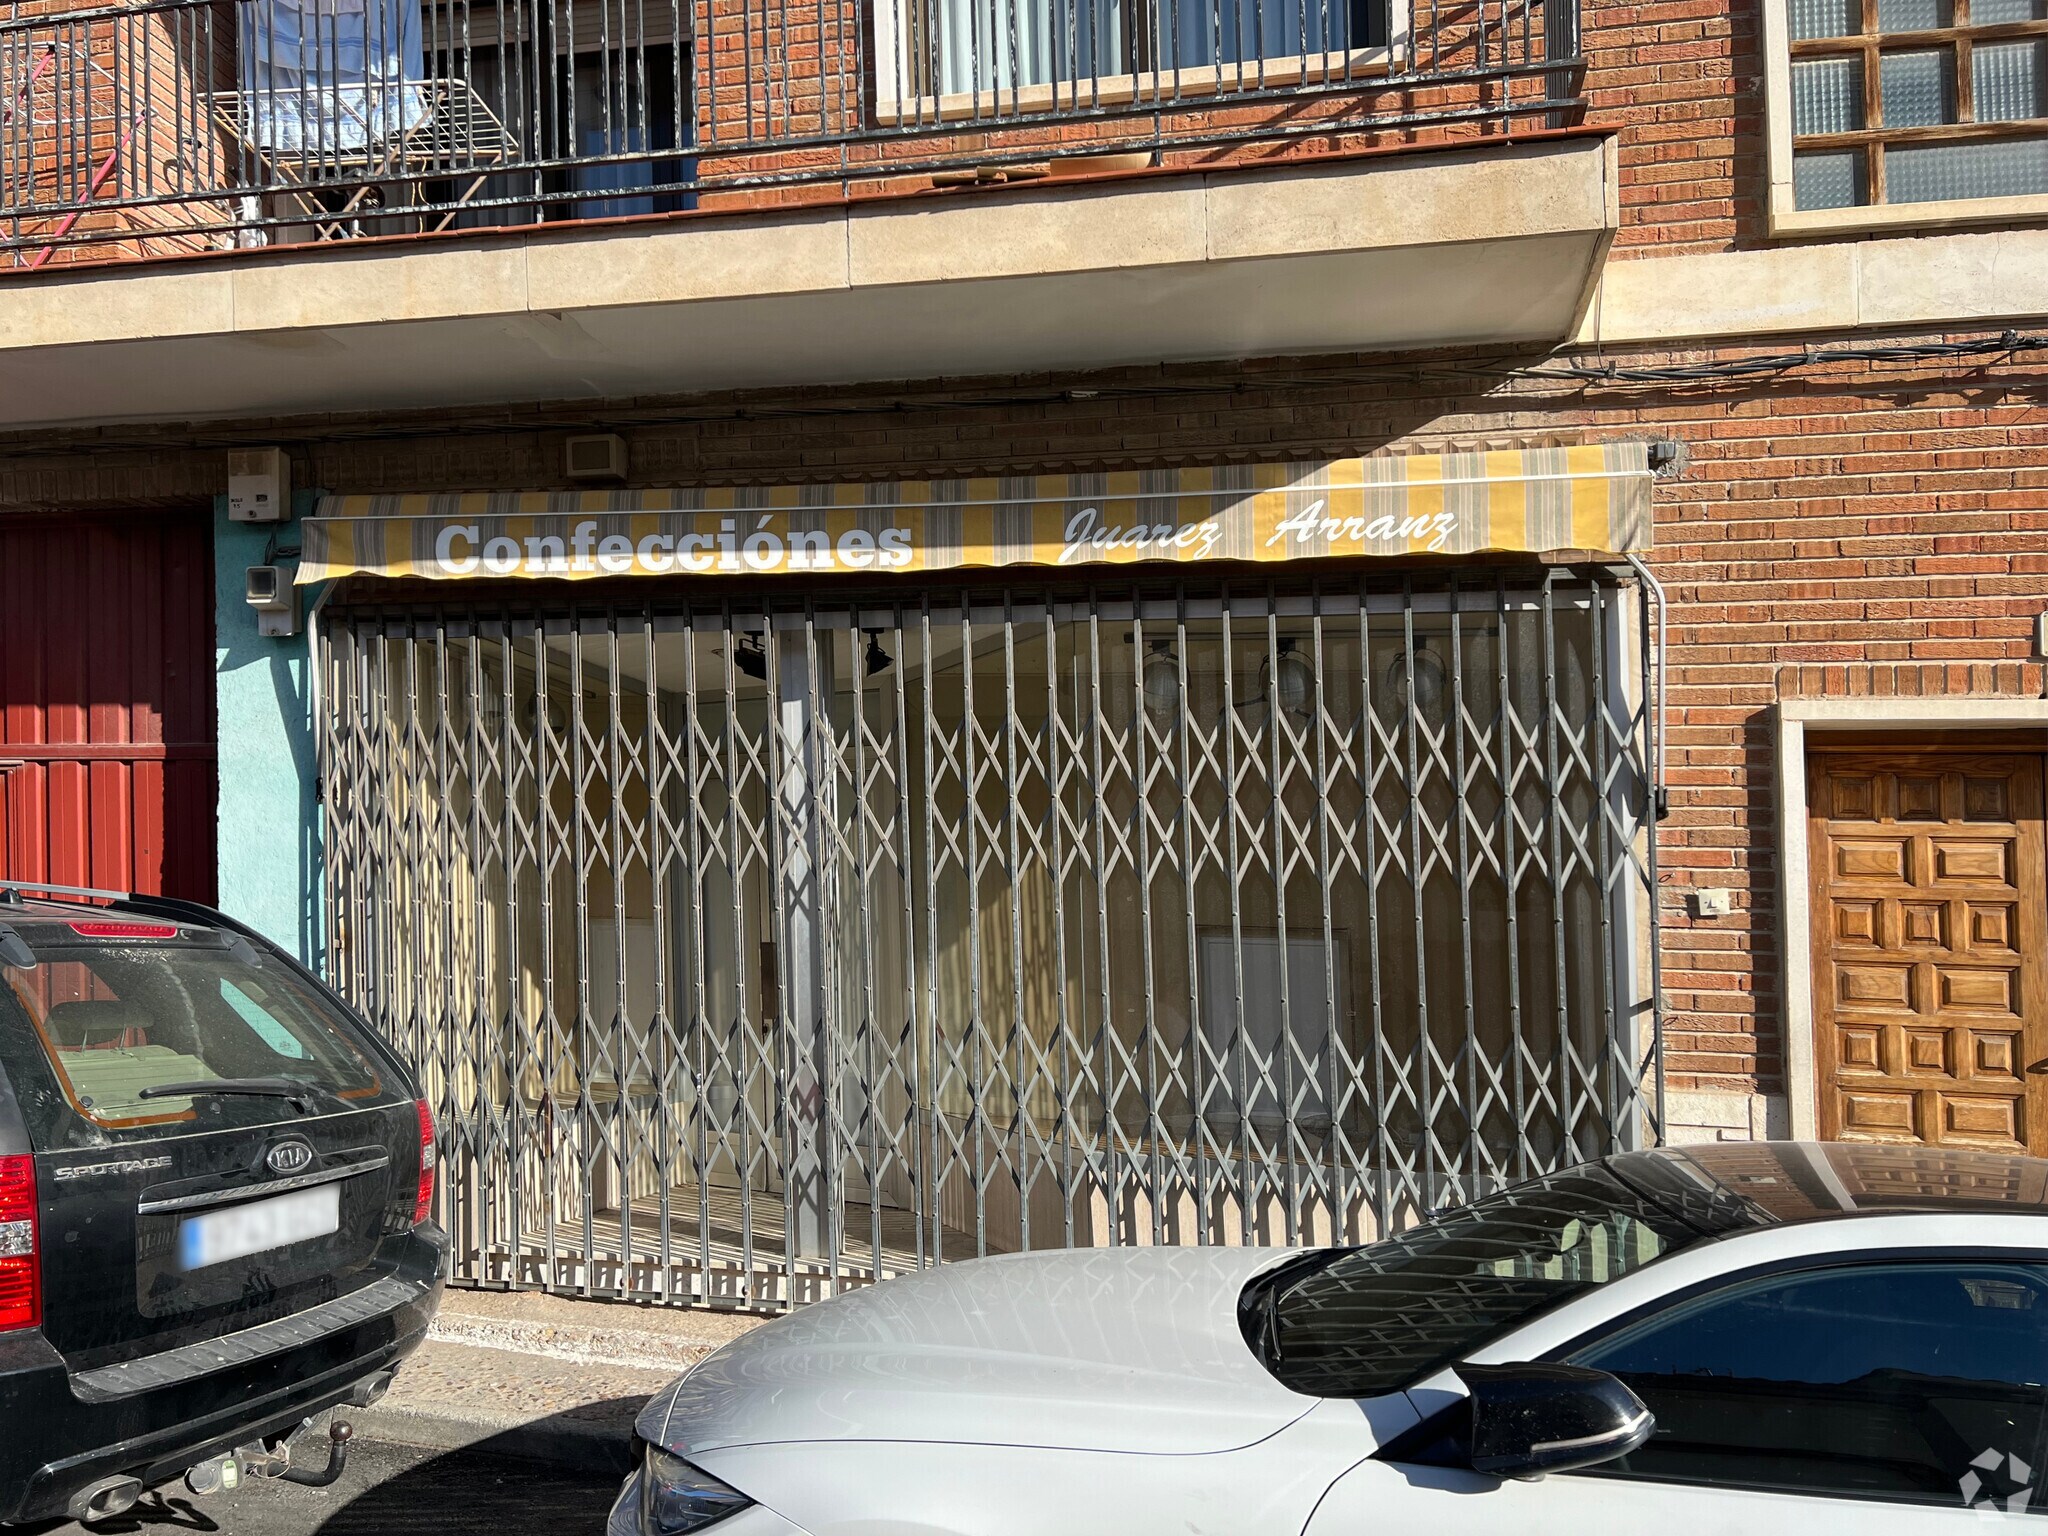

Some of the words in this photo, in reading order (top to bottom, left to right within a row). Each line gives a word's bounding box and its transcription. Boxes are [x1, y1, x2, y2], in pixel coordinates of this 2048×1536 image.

[436, 515, 914, 573] Confecciónes
[1058, 507, 1223, 563] Juarez
[1265, 500, 1459, 552] Arranz
[54, 1156, 172, 1180] SPORTAGE
[275, 1147, 305, 1168] KIA
